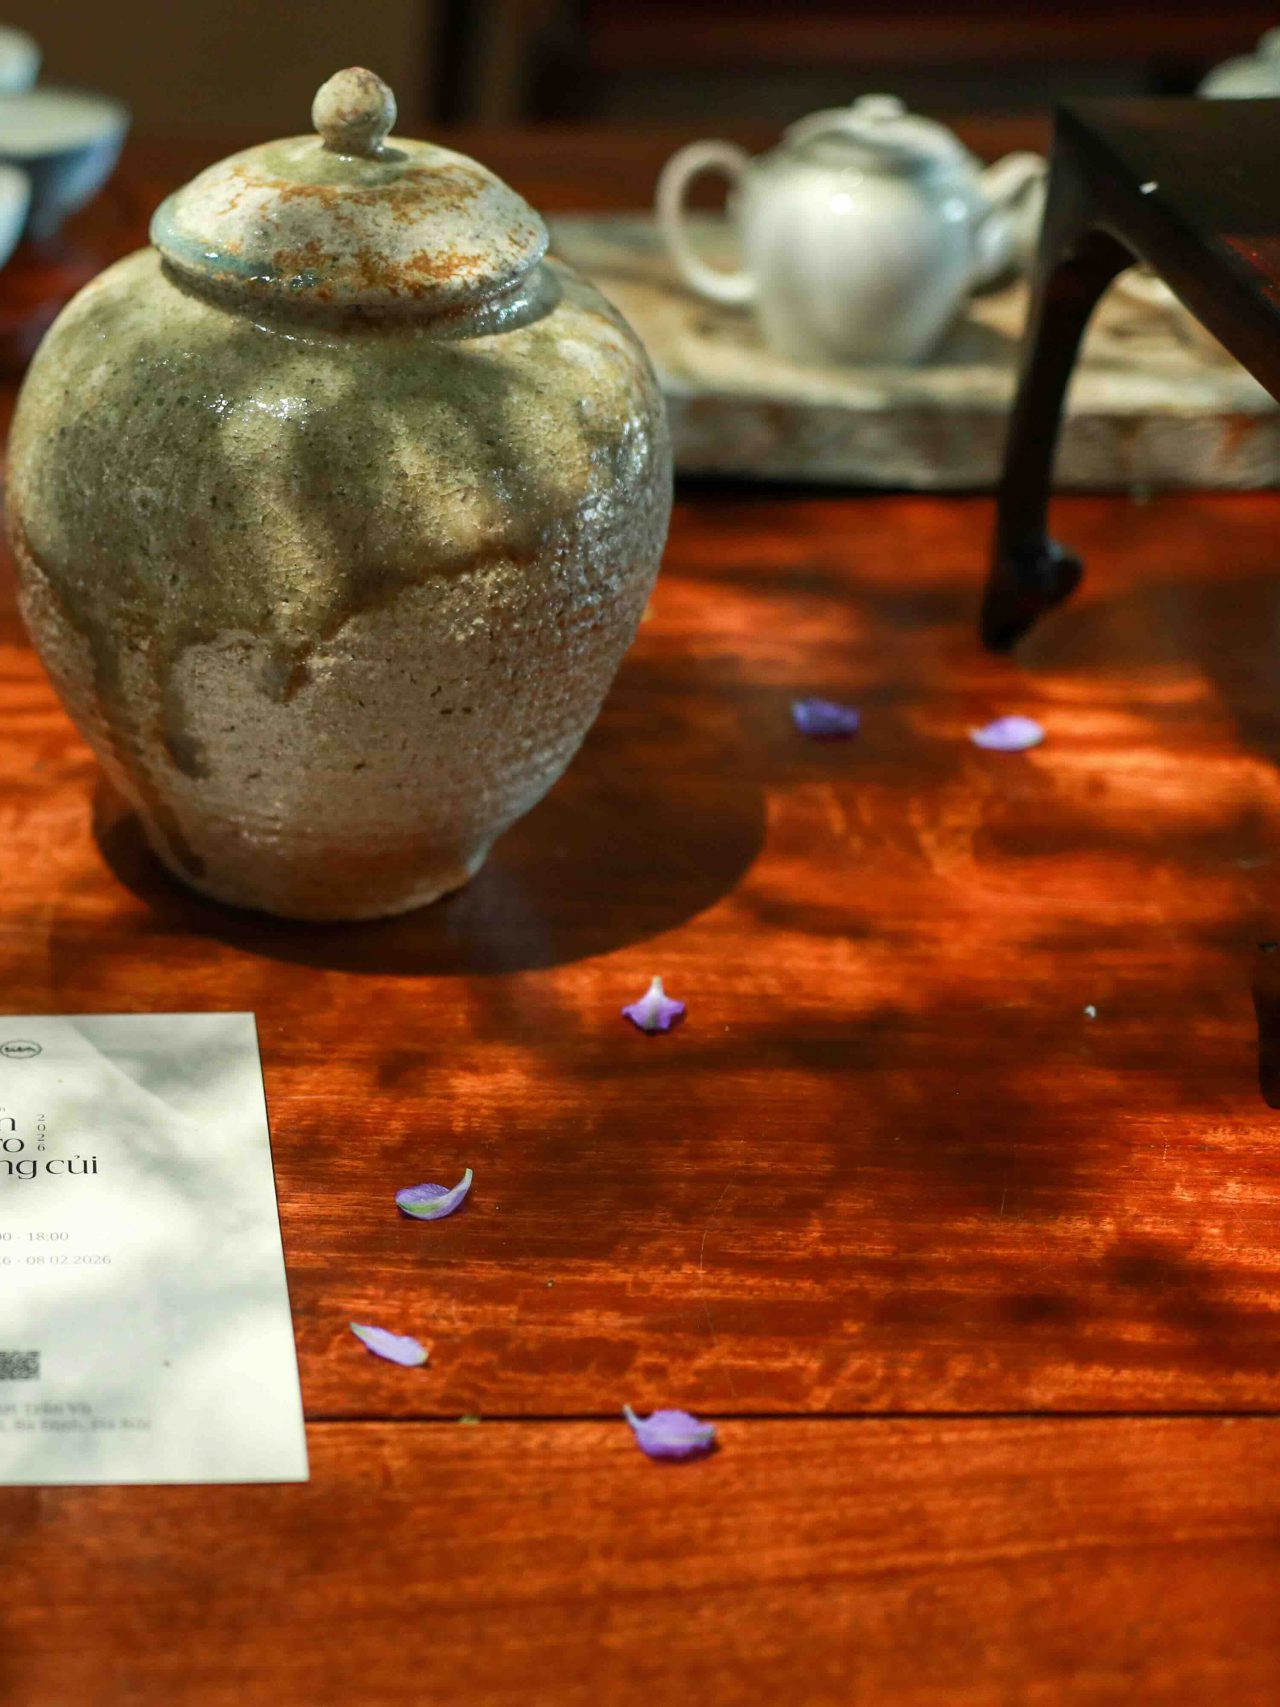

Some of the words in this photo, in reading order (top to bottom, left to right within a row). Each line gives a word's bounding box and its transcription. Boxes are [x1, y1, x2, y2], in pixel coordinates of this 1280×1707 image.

[36, 1113, 46, 1152] 2026
[45, 1154, 98, 1175] củi
[27, 1231, 70, 1242] 18:00
